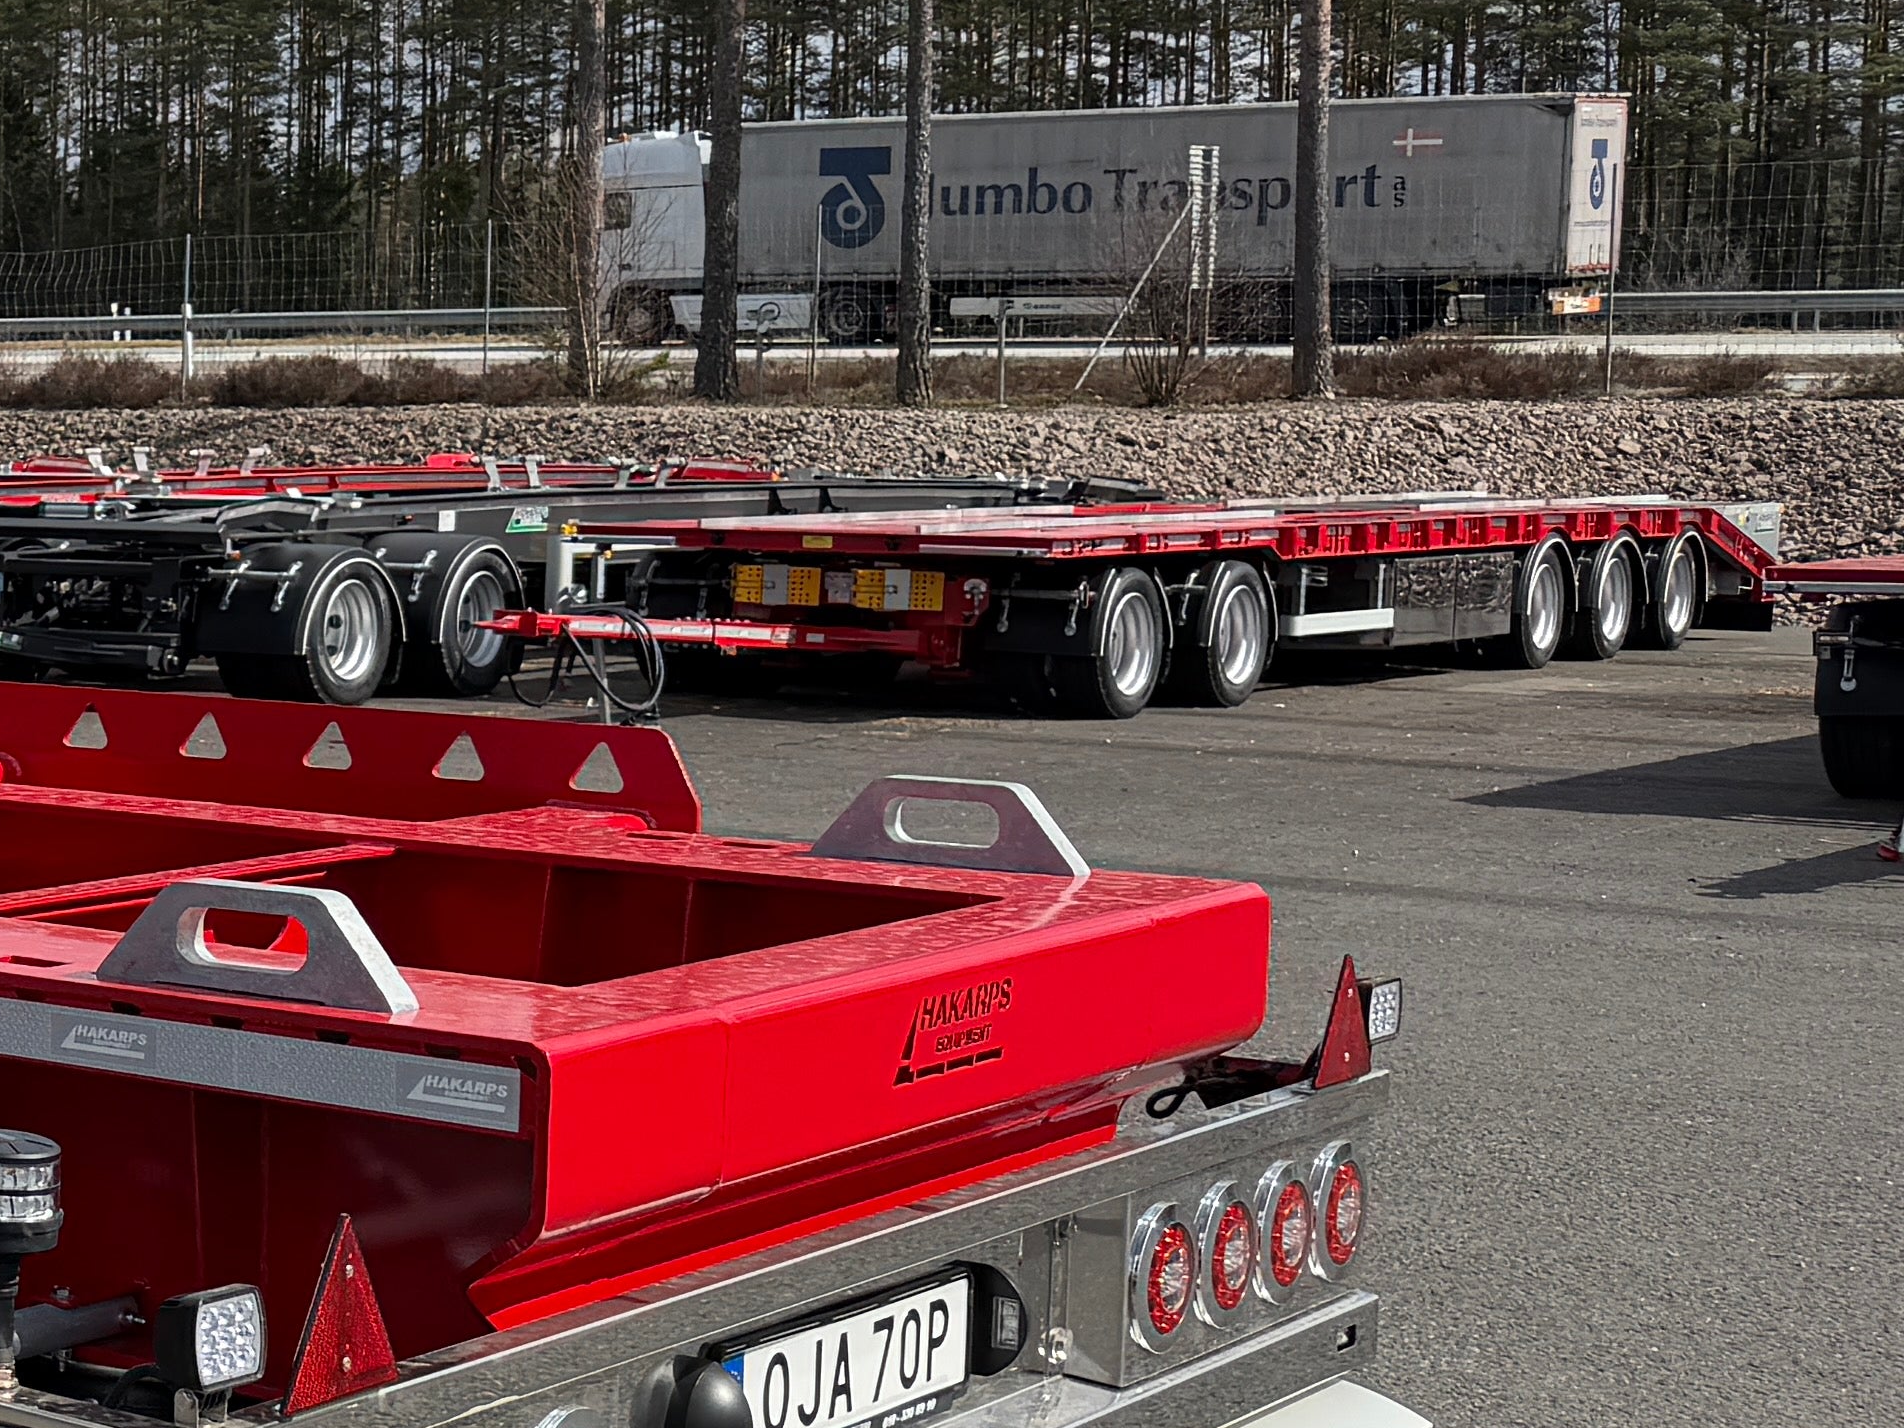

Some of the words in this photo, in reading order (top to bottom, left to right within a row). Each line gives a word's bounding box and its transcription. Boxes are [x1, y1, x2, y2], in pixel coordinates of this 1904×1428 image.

[929, 167, 1092, 218] umbo
[1103, 164, 1380, 226] Trasprt
[920, 977, 1013, 1031] HAKARPS
[77, 1024, 148, 1046] HAKARPS
[425, 1074, 508, 1098] HAKARPS
[872, 1298, 950, 1402] 70P
